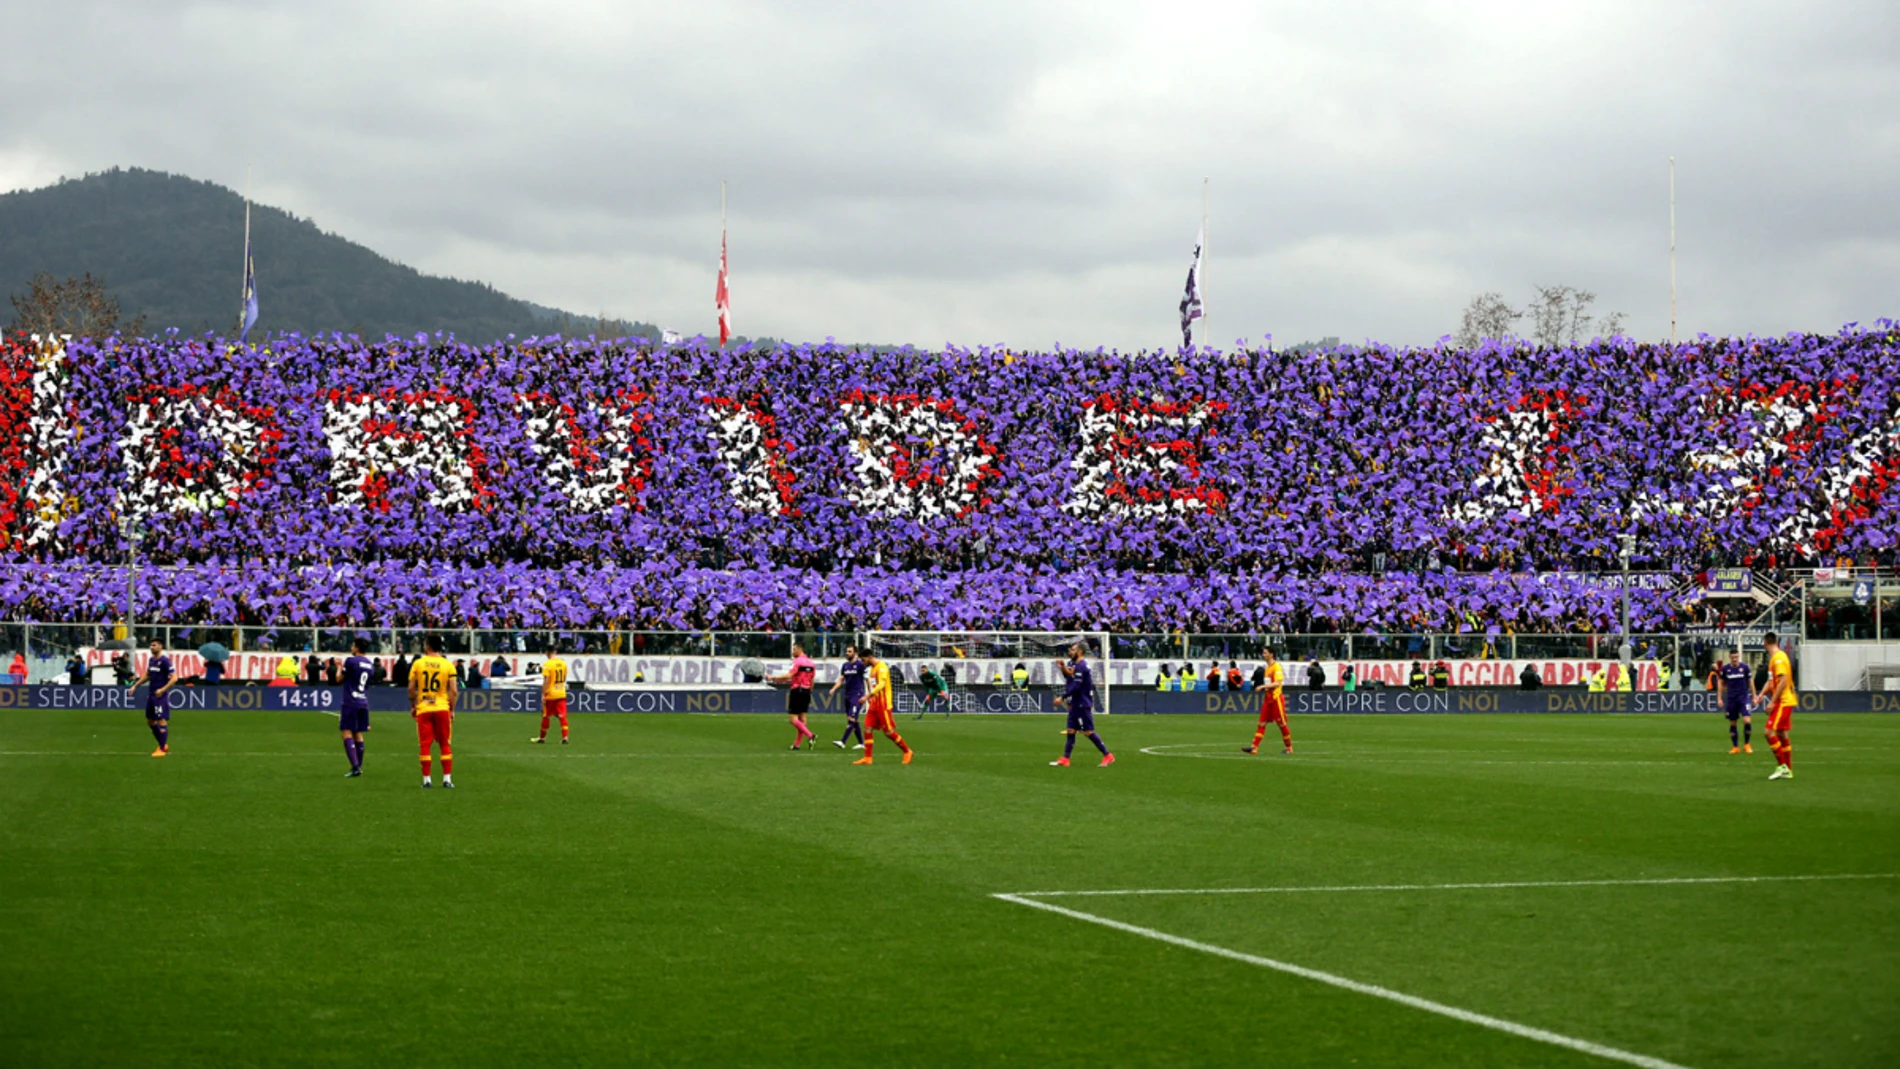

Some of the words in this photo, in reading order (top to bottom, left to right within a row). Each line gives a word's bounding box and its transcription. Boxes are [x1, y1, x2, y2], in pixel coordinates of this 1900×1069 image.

[357, 671, 369, 692] 9
[422, 670, 441, 693] 16
[38, 687, 136, 708] SEMPRE
[168, 689, 205, 709] ON
[217, 690, 262, 709] NOI
[278, 689, 332, 708] 14:19
[617, 692, 675, 712] CON
[687, 693, 730, 711] NOI
[986, 692, 1041, 712] CON
[1298, 693, 1386, 712] SEMPRE
[1396, 692, 1448, 712] CON
[1459, 694, 1499, 711] NOI
[1548, 694, 1628, 711] DAVIDE
[1634, 693, 1717, 712] SEMPRE
